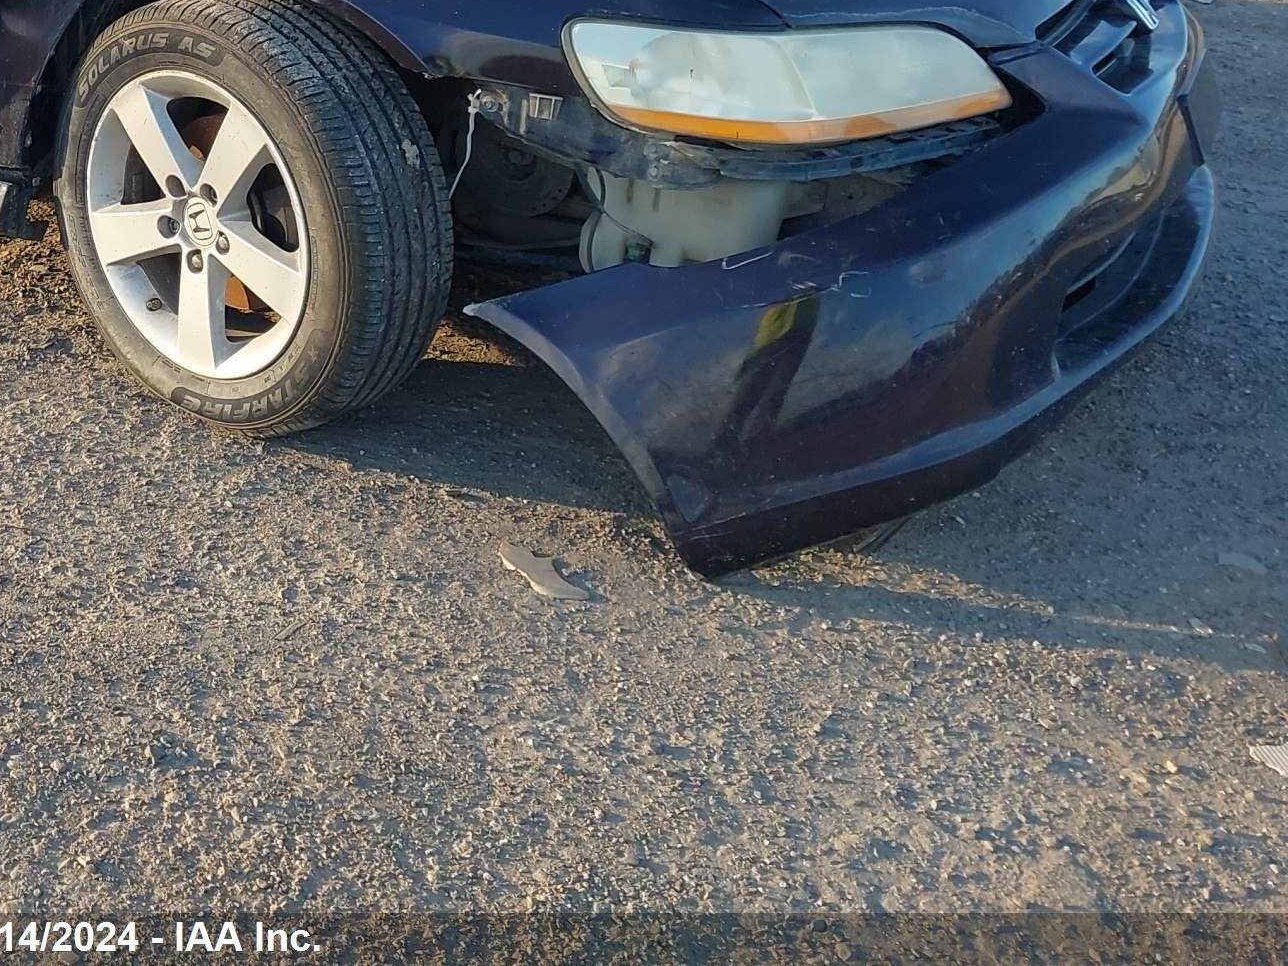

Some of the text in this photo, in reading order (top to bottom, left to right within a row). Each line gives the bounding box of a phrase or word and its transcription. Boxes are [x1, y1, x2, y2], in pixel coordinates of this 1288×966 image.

[78, 33, 217, 101] SOLARUS AS
[180, 360, 309, 420] STARFIRE
